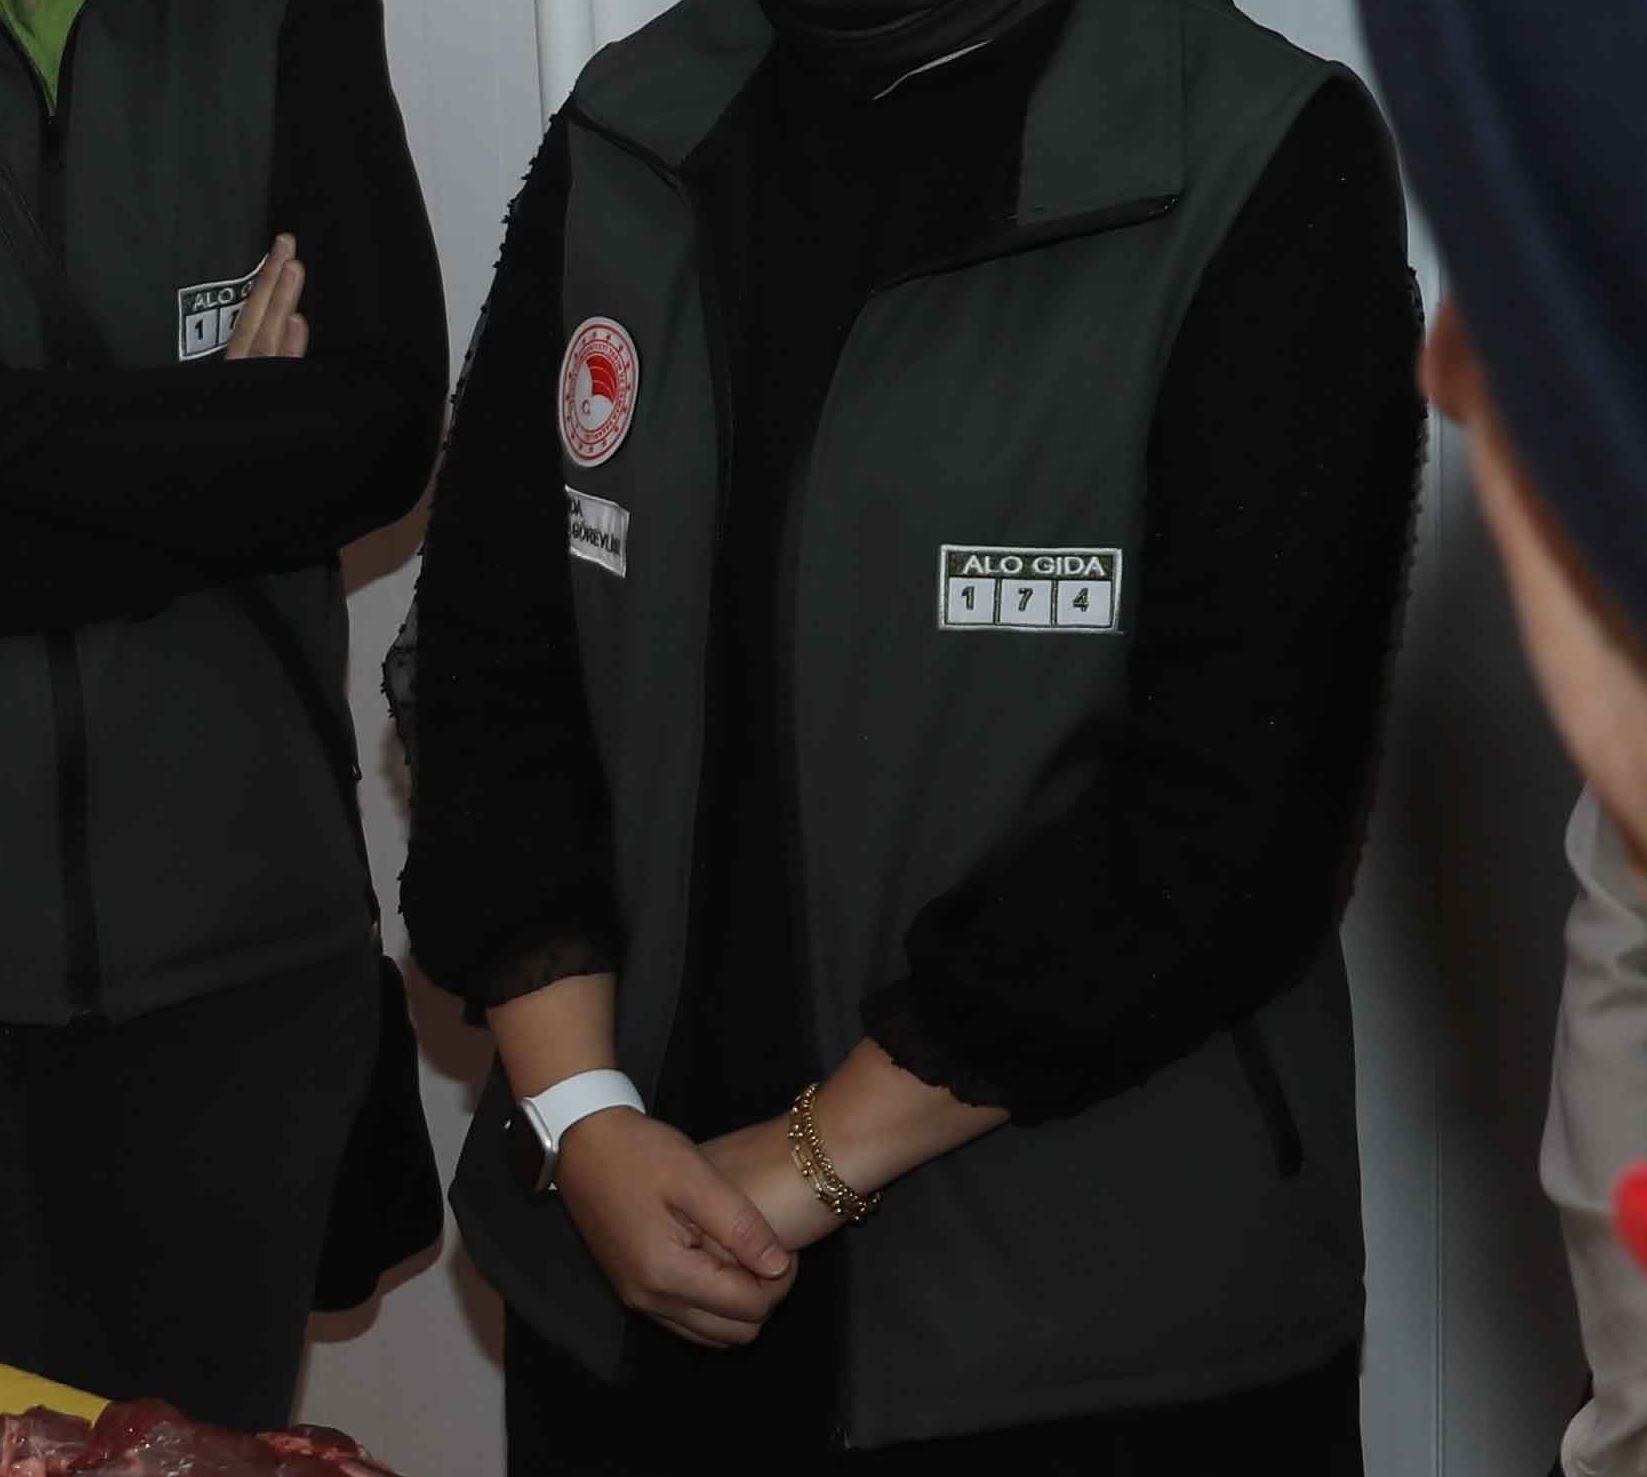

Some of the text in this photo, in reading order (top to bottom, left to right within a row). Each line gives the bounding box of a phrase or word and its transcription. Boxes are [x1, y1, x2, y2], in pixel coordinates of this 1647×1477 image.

[193, 287, 234, 311] ALO
[195, 320, 204, 340] 1
[963, 555, 1105, 576] ALO GIDA
[962, 585, 1089, 612] 1 7 4
